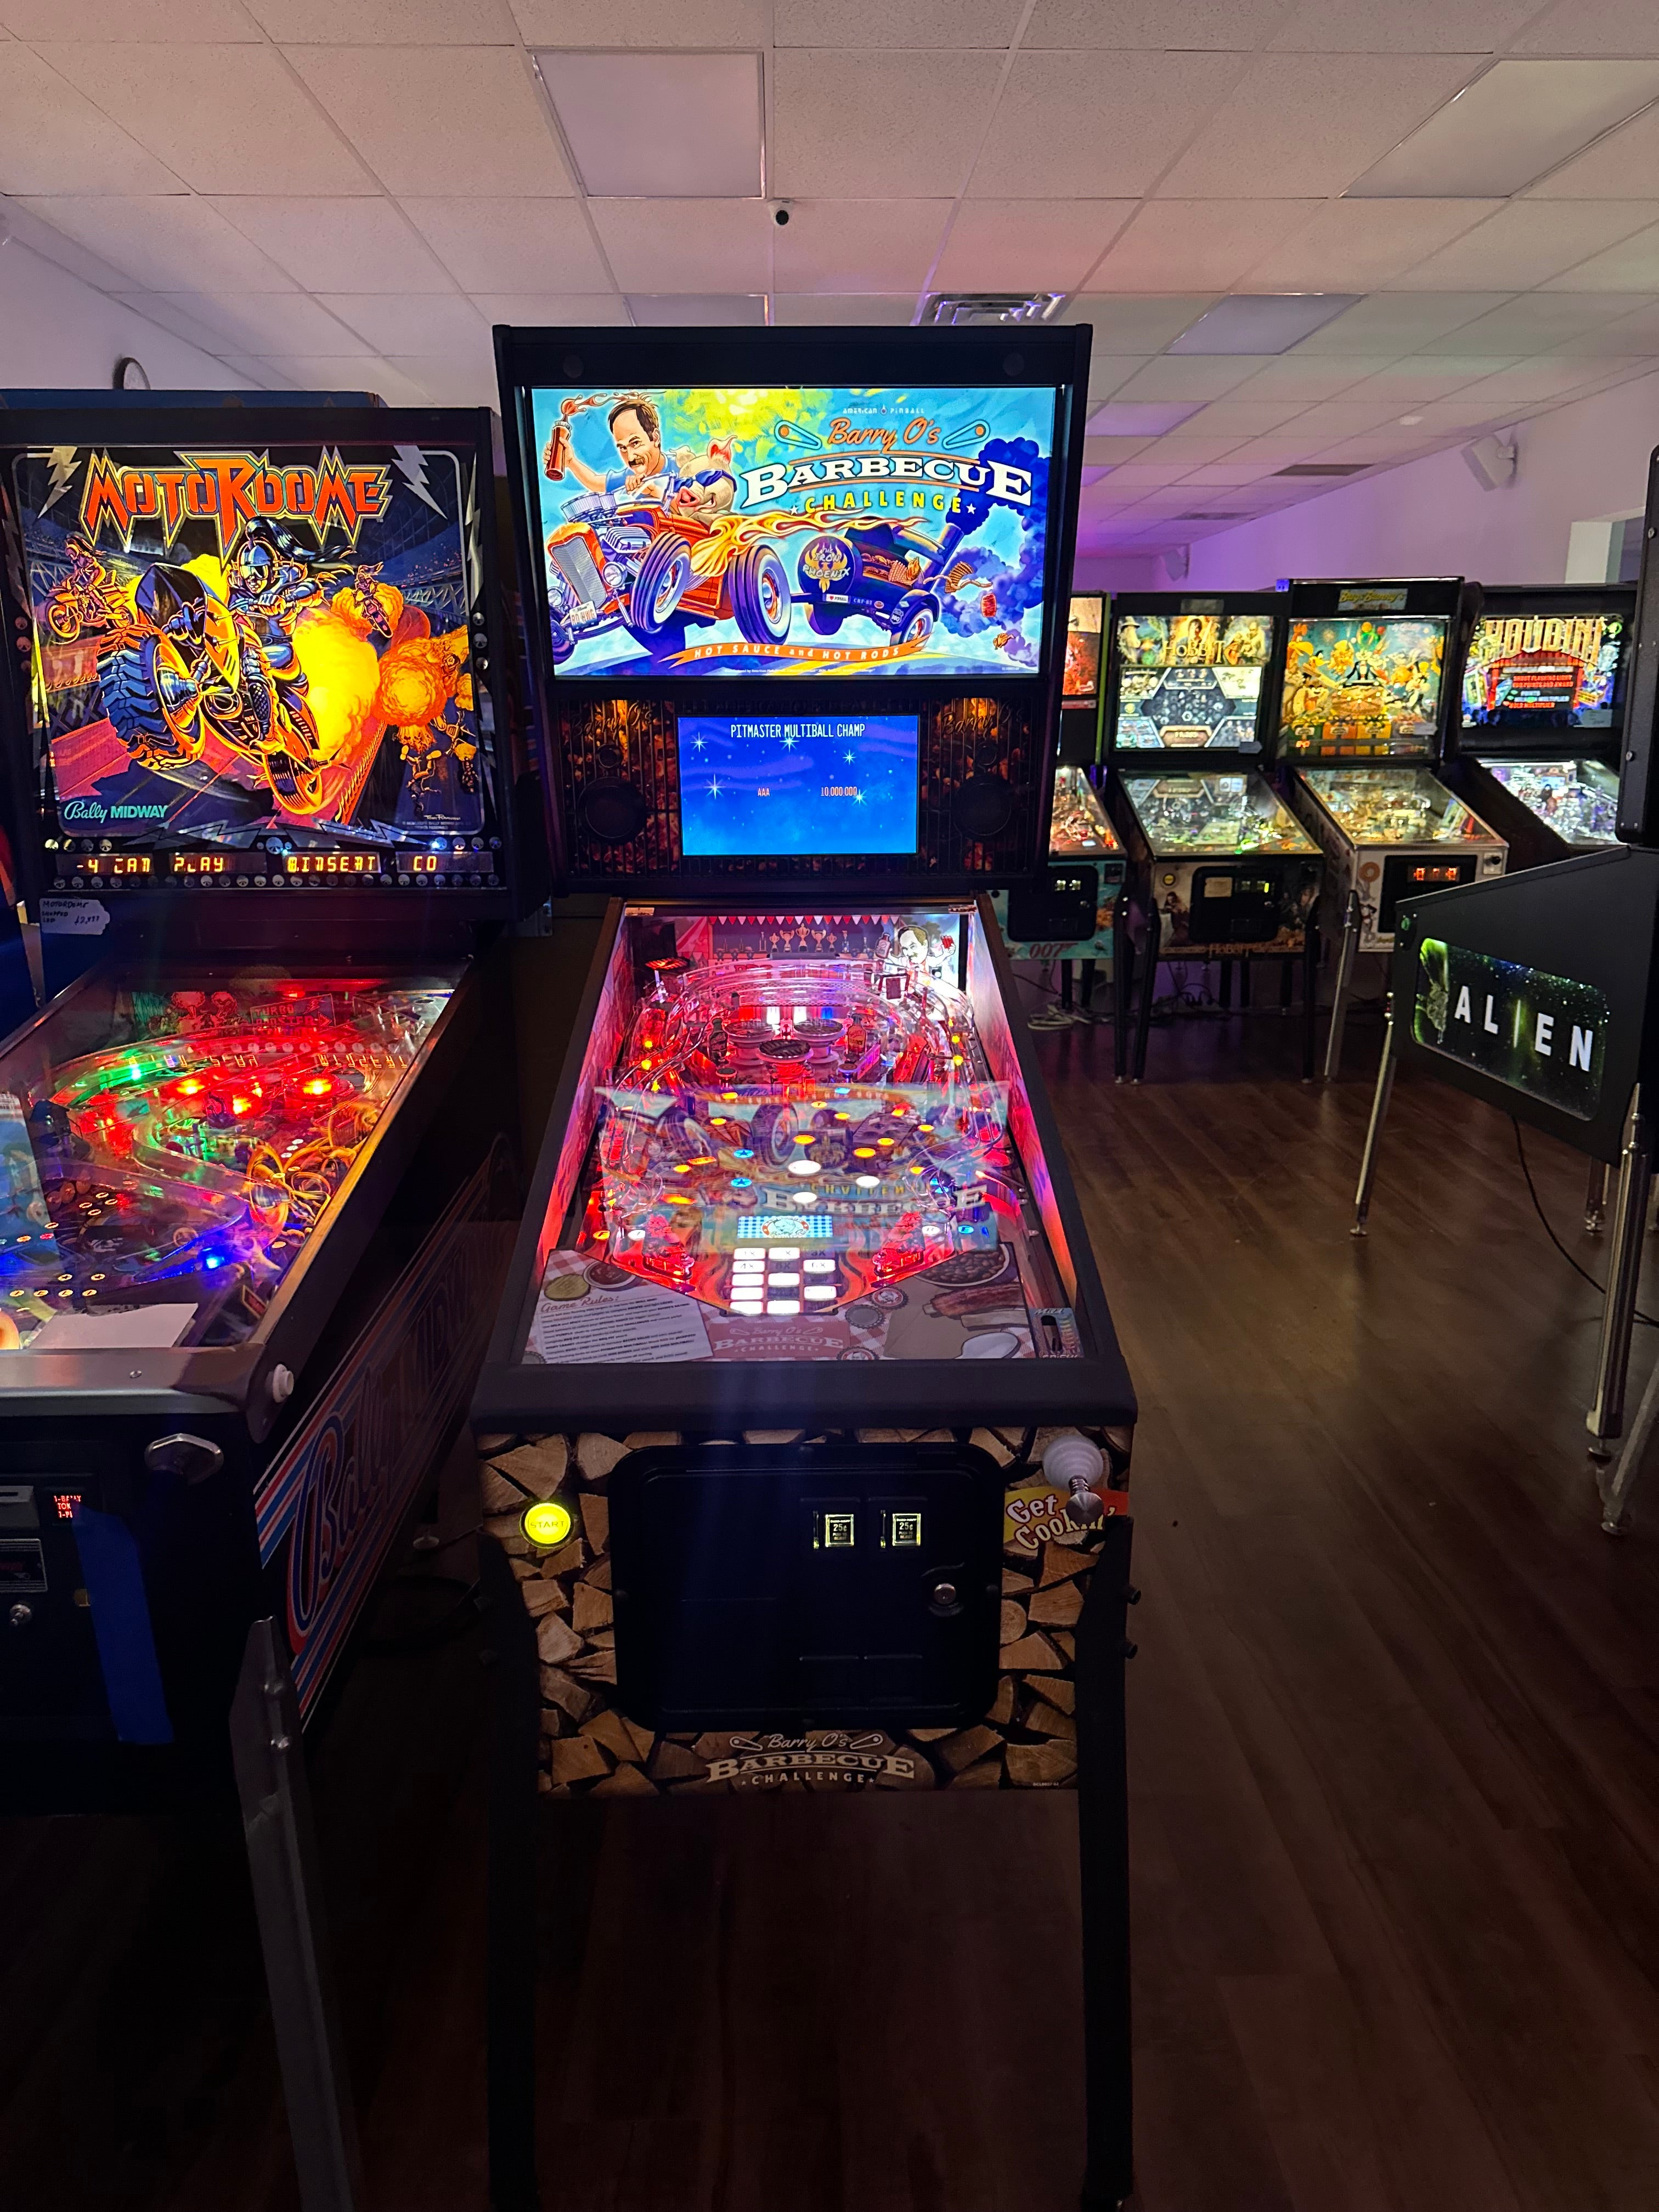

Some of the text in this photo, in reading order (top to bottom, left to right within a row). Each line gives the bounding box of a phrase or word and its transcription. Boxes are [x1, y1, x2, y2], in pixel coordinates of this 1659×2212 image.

[828, 417, 941, 454] Barry O's
[740, 457, 1031, 508] BARBECUE
[81, 451, 388, 568] MOTORDOME
[805, 491, 961, 514] CHALLENGE
[814, 552, 840, 562] IRON
[803, 564, 850, 578] PHOENIX
[1485, 618, 1603, 665] HOUDINI
[694, 645, 899, 660] HOT SAUCE and HOT RODS
[1161, 640, 1226, 663] HOBBIT
[731, 723, 865, 738] PITMASTER MULTIBALL CHAMP
[941, 712, 994, 741] Barry
[757, 786, 857, 797] AAA 10,000,000
[64, 801, 168, 823] Bally MIDWAY
[413, 856, 437, 871] CO
[1029, 943, 1078, 958] 007
[255, 1003, 295, 1015] TURBO
[1454, 986, 1593, 1072] ALIEN
[541, 1302, 576, 1313] Game
[580, 1295, 619, 1306] Rules:
[753, 1326, 802, 1336] Barry O's
[713, 1335, 844, 1351] BARBECUE
[1006, 1493, 1058, 1523] Get
[833, 1523, 847, 1532] 25¢
[899, 1522, 913, 1531] 25¢
[768, 1733, 848, 1752] Barry O's
[706, 1753, 915, 1783] BARBECUE
[751, 1771, 865, 1785] CHALLENGE
